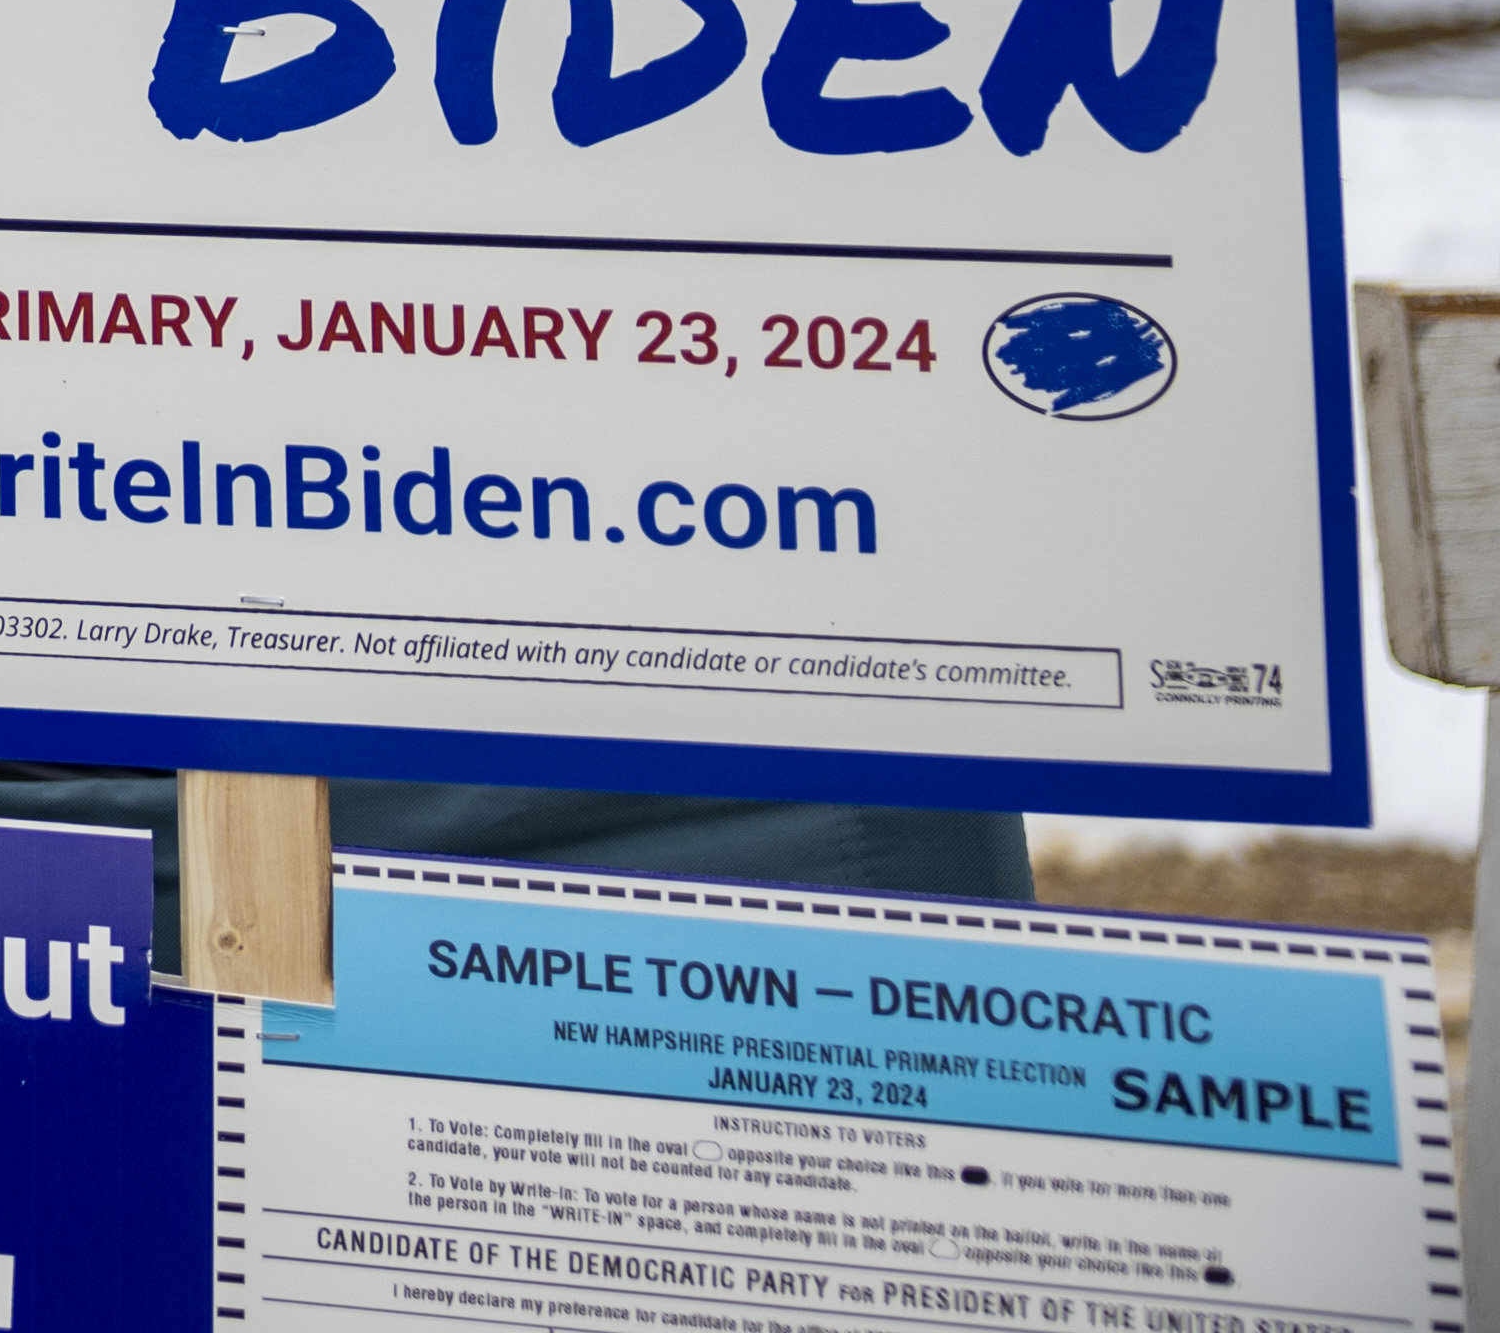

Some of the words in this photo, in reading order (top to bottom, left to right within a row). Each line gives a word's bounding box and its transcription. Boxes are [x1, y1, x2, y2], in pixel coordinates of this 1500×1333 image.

[277, 299, 613, 361] JANUARY
[635, 310, 738, 379] 23,
[761, 314, 937, 373] 2024
[76, 619, 138, 649] Larry
[144, 622, 218, 650] Drake,
[227, 626, 344, 653] Treasurer.
[354, 632, 397, 656] Not
[403, 633, 510, 664] affiliated
[516, 640, 567, 664] with
[574, 647, 620, 673] any
[626, 646, 747, 673] candidate
[754, 656, 782, 674] or
[788, 654, 927, 681] candidate's
[935, 663, 1072, 688] committee.
[1251, 663, 1283, 694] 74
[1155, 692, 1220, 704] CONNOLLY
[1224, 695, 1283, 708] PRINTING
[428, 939, 633, 995] SAMPLE
[645, 957, 798, 1009] TOWN
[869, 976, 1213, 1045] DEMOCRATIC
[554, 1020, 599, 1044] NEW
[605, 1025, 725, 1055] HAMPSHIRE
[732, 1035, 879, 1069] PRESIDENTIAL
[884, 1049, 979, 1078] PRIMARY
[986, 1058, 1087, 1089] ELECTION
[708, 1066, 818, 1098] JANUARY
[827, 1076, 863, 1106] 23,
[871, 1080, 928, 1109] 2024
[714, 1115, 832, 1140] INSTRUCTIONS
[837, 1126, 858, 1143] TO
[862, 1128, 926, 1149] VOTERS
[1113, 1068, 1372, 1134] SAMPLE
[317, 1227, 458, 1262] CANDIDATE
[469, 1241, 499, 1266] OF
[509, 1245, 557, 1272] THE
[568, 1251, 735, 1290] DEMOCRATIC
[746, 1268, 829, 1299] PARTY
[839, 1284, 875, 1304] FOR
[882, 1282, 1029, 1320] PRESIDENT
[1041, 1296, 1076, 1324] OF
[1084, 1299, 1137, 1330] THE
